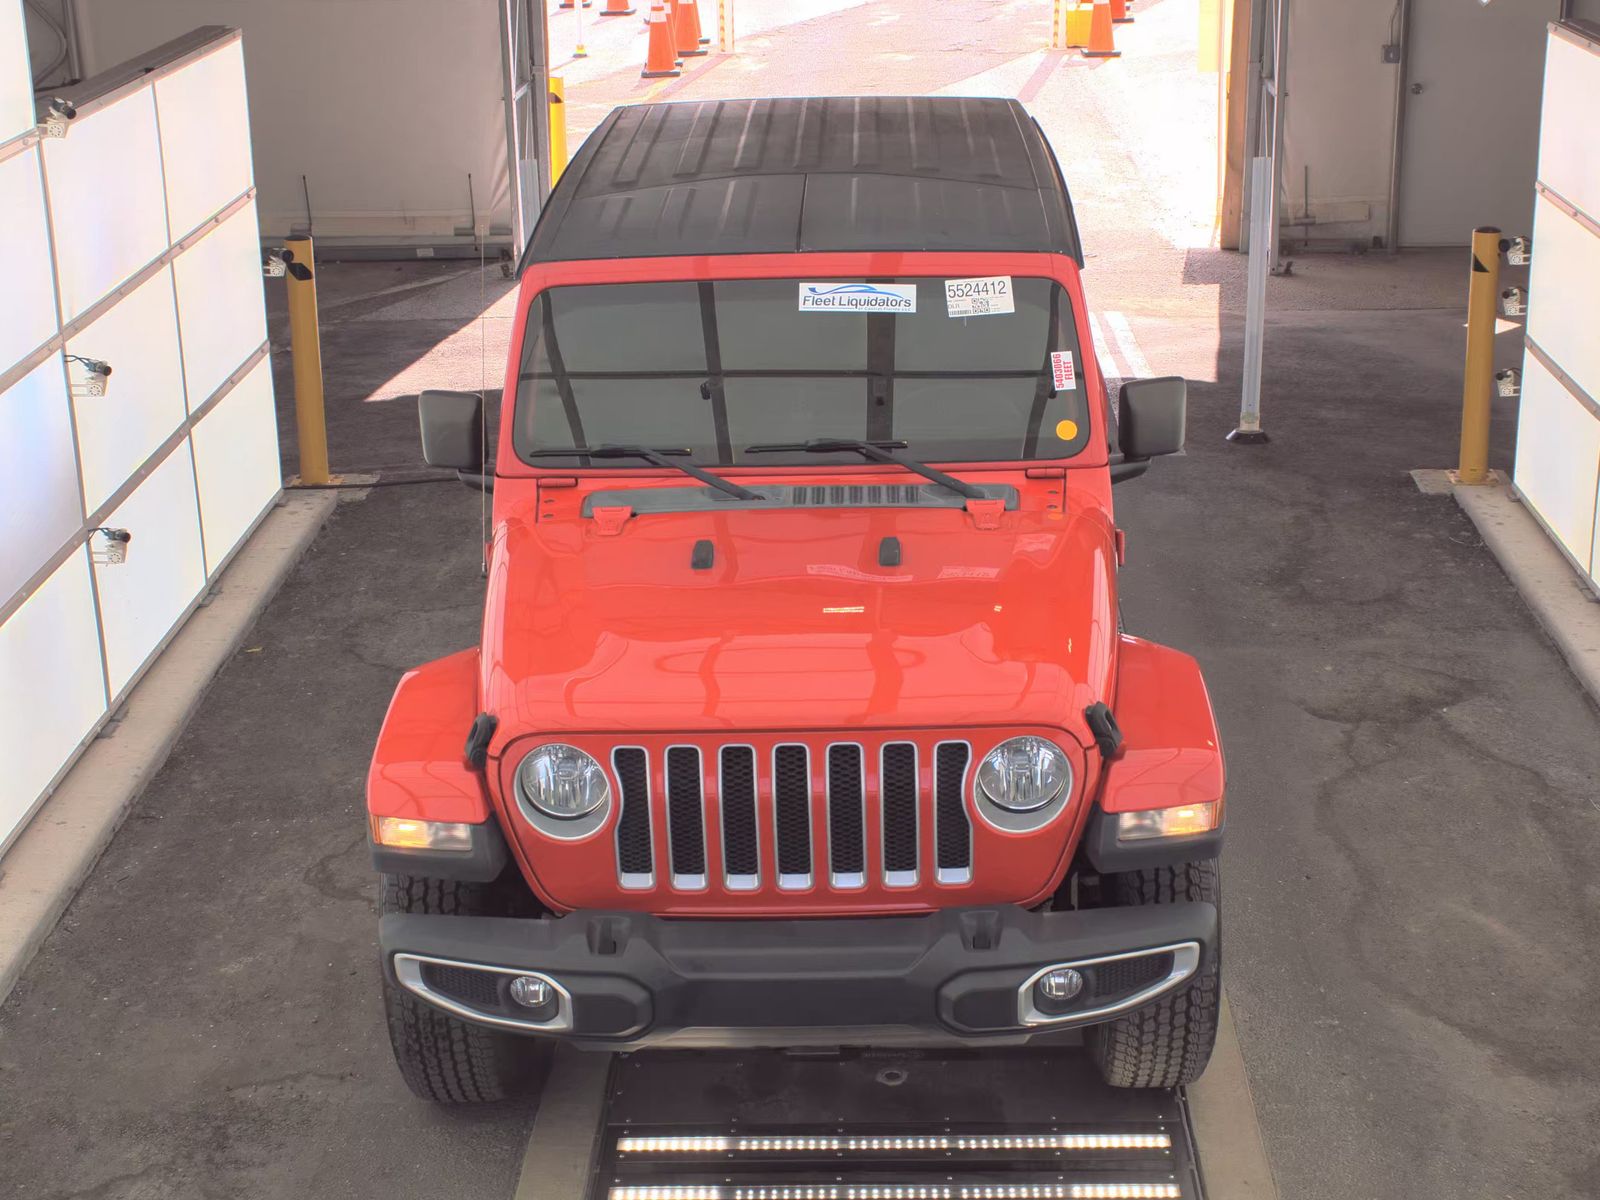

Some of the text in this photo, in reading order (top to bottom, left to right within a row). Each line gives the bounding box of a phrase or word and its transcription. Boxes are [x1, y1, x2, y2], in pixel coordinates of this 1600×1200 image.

[948, 280, 1007, 298] 5524412
[802, 295, 912, 309] Fleet Liquidators
[1053, 353, 1064, 389] 5403066
[1063, 361, 1073, 380] FLEET
